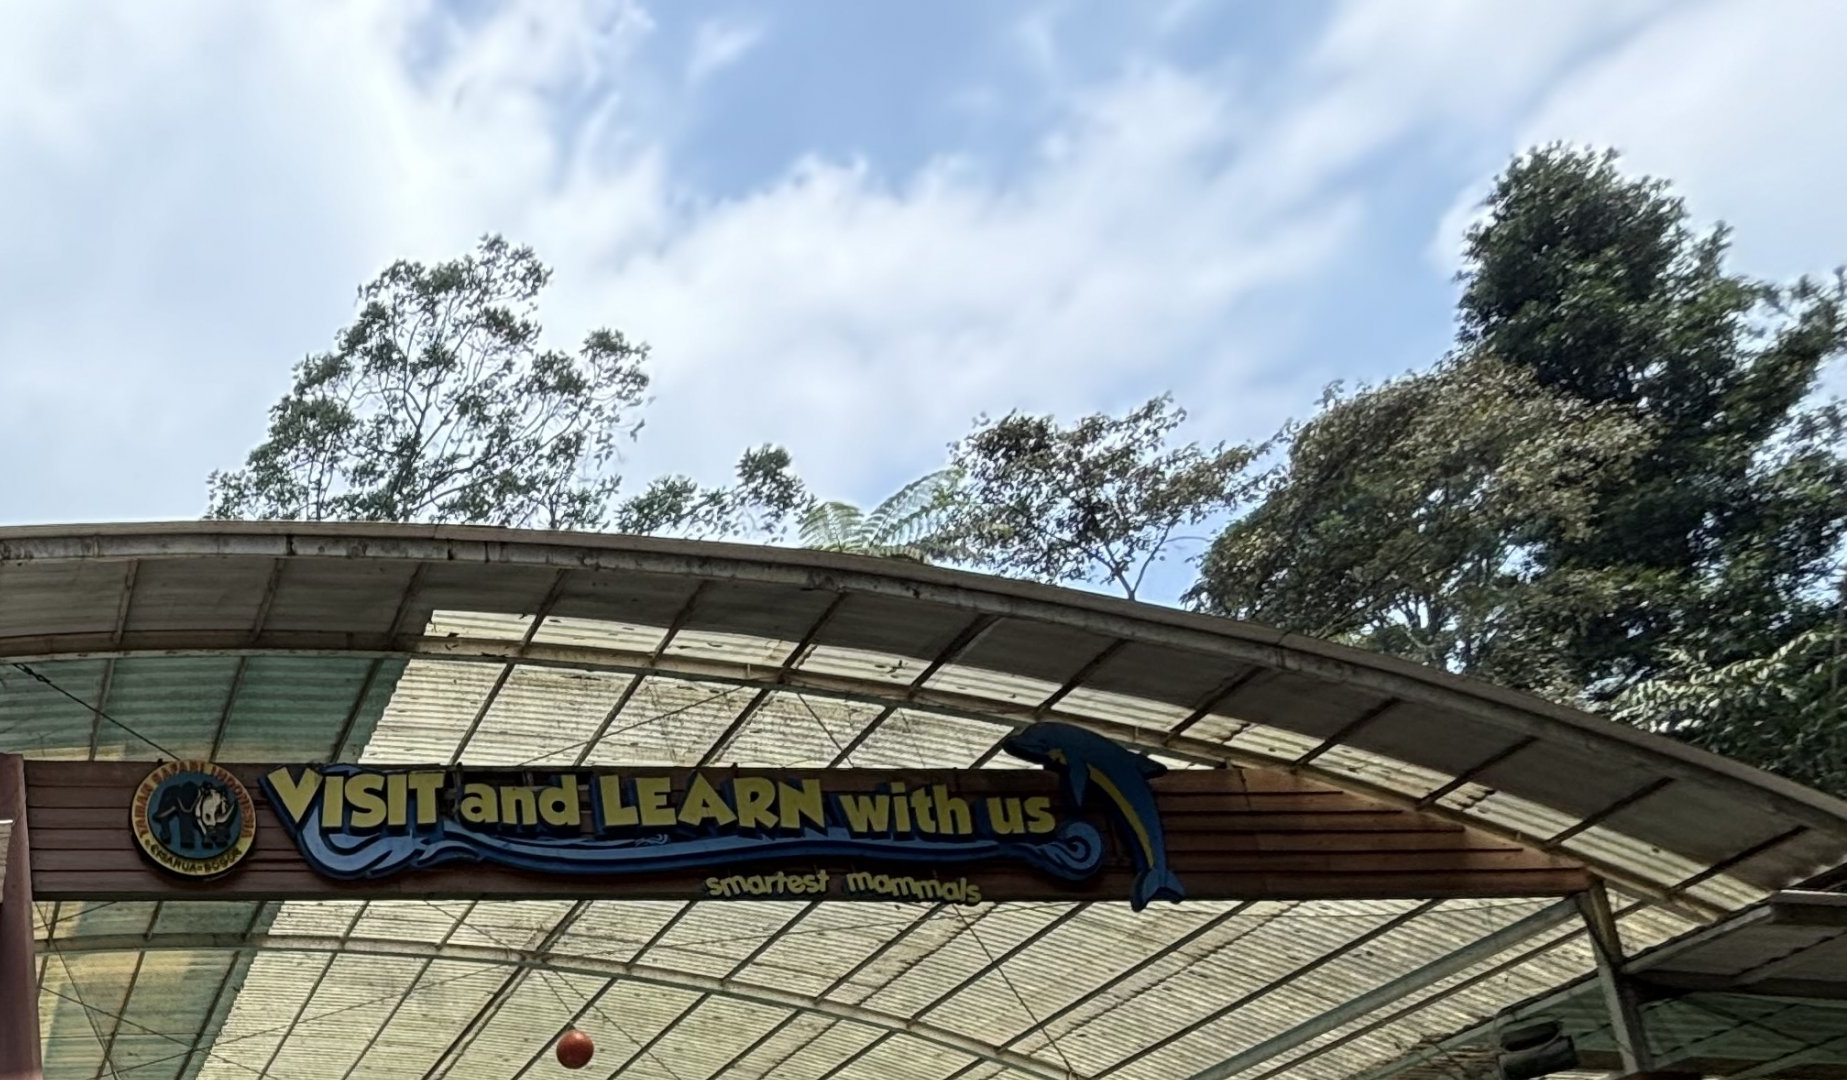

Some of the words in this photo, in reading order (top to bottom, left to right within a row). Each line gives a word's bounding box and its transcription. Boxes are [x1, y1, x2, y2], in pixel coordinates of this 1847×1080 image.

[267, 766, 446, 829] VISIT
[459, 773, 581, 827] and
[598, 772, 827, 830] LEARN
[839, 781, 973, 835] with
[986, 796, 1056, 835] us
[705, 868, 831, 898] smartest
[845, 870, 982, 903] mammals
